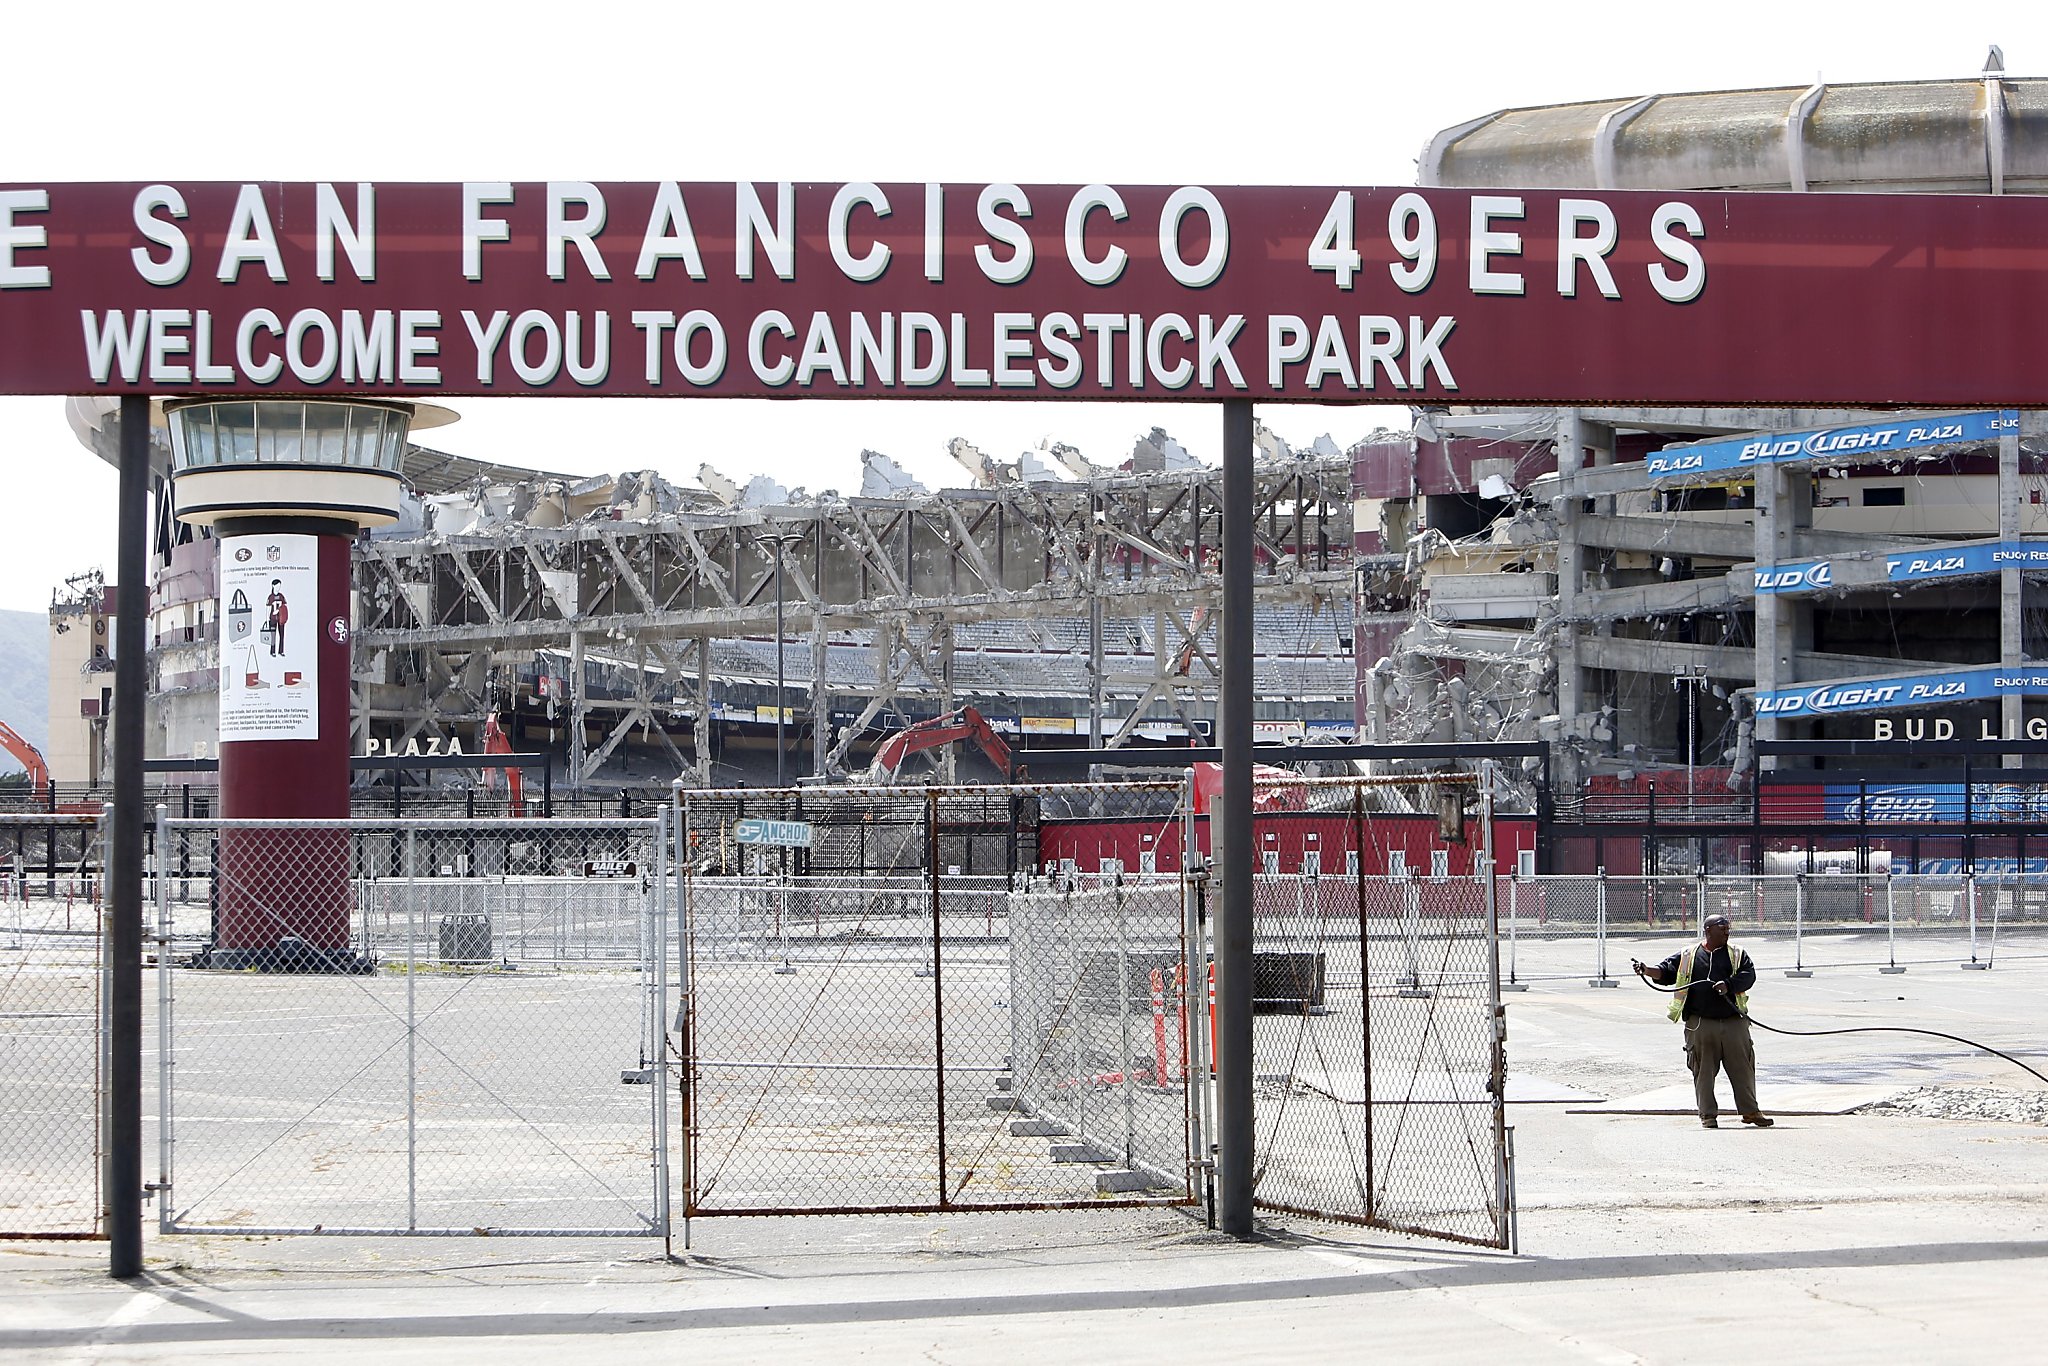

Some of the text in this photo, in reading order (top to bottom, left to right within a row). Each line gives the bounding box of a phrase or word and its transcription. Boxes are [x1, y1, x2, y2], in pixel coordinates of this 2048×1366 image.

[131, 183, 376, 286] SAN
[462, 182, 1229, 288] FRANCISCO
[1307, 188, 1706, 303] 49ERS
[81, 308, 1459, 392] WELCOME YOU TO CANDLESTICK PARK
[1648, 455, 1703, 473] PLAZA
[1739, 440, 1801, 461] BUD
[1814, 429, 1899, 453] LIGHT
[1906, 424, 1963, 443] PLAZA
[1908, 556, 1965, 574] PLAZA
[1993, 551, 2028, 562] ENJOY
[1815, 685, 1902, 708] LIGHT
[1909, 681, 1965, 699] PLAZA
[1994, 677, 2029, 687] ENJOY
[1874, 717, 2048, 741] BUD LIG
[365, 737, 464, 757] PLAZA
[1871, 797, 1935, 810] BUD
[761, 822, 809, 843] ANCHOR
[591, 862, 630, 871] BAILEY
